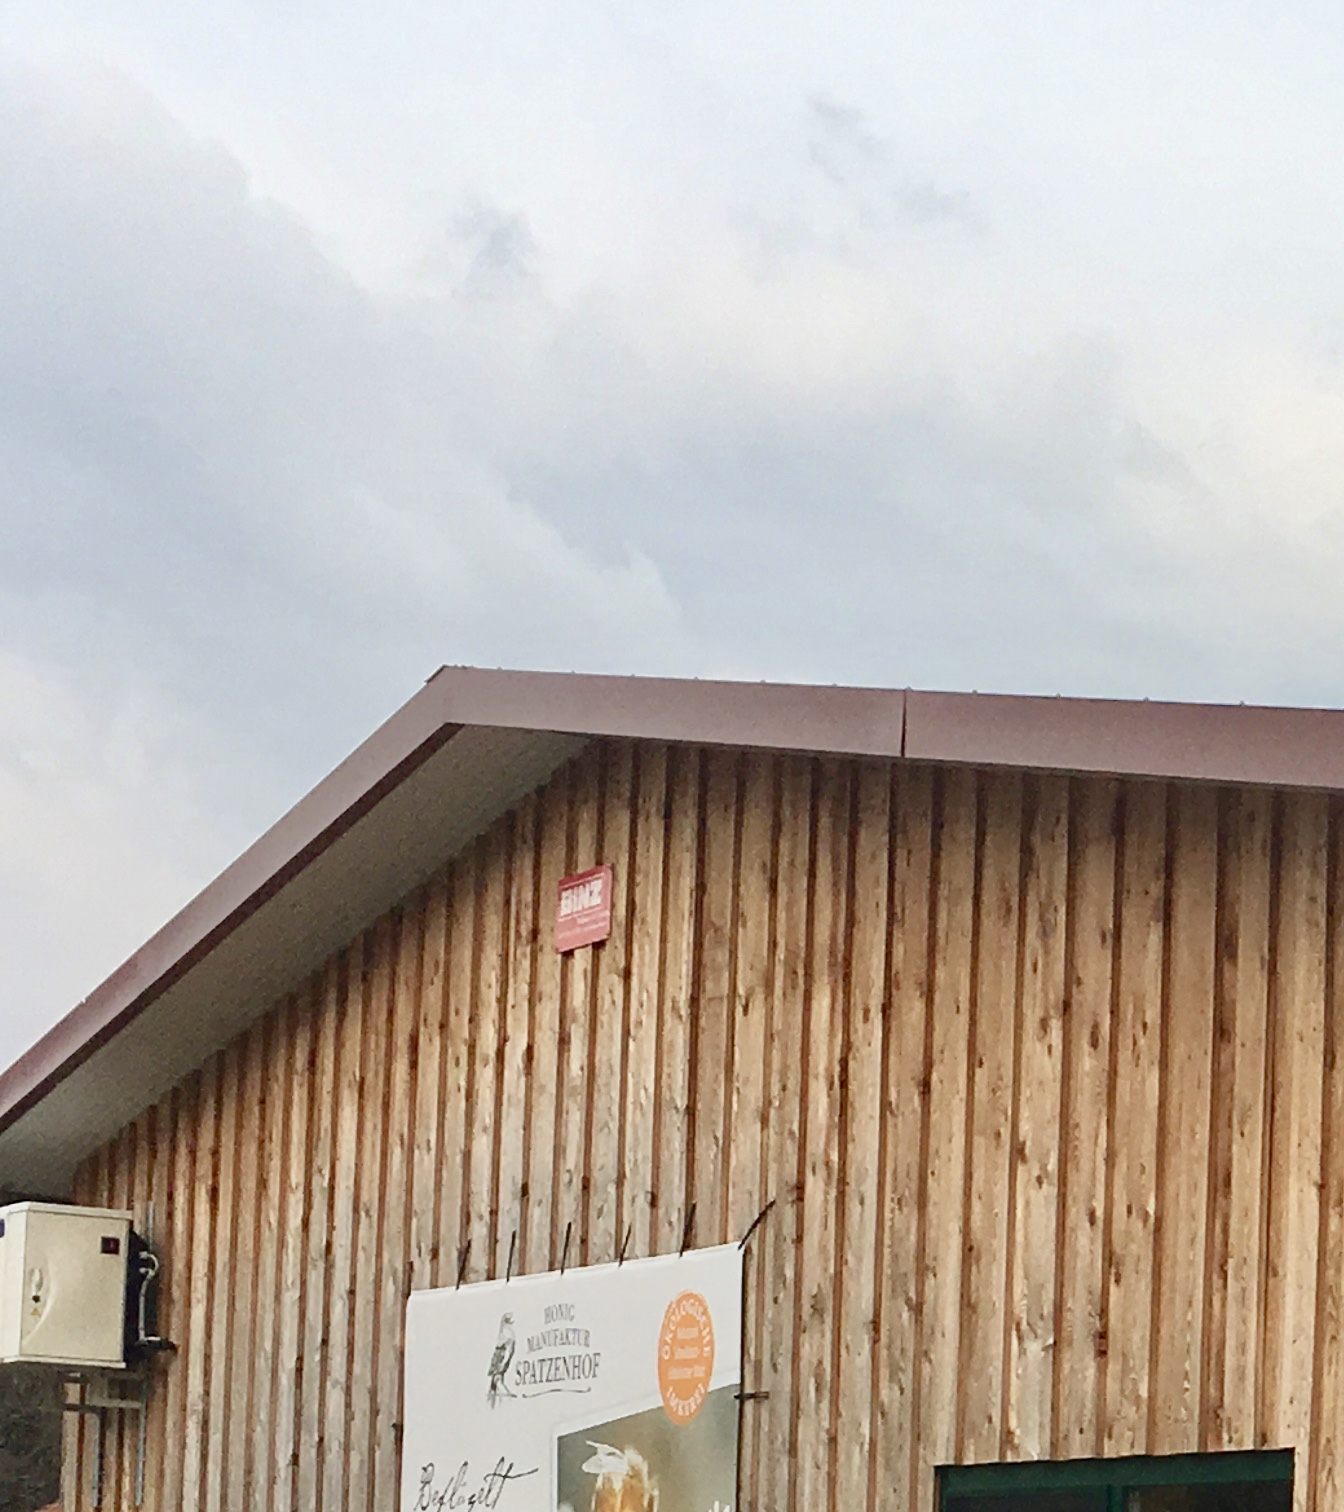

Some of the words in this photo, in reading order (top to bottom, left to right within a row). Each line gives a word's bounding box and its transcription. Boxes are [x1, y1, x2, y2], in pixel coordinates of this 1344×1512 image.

[544, 1303, 575, 1325] HONIG
[526, 1328, 590, 1353] MANUFAKTUR
[515, 1352, 600, 1386] SPATZENHOF
